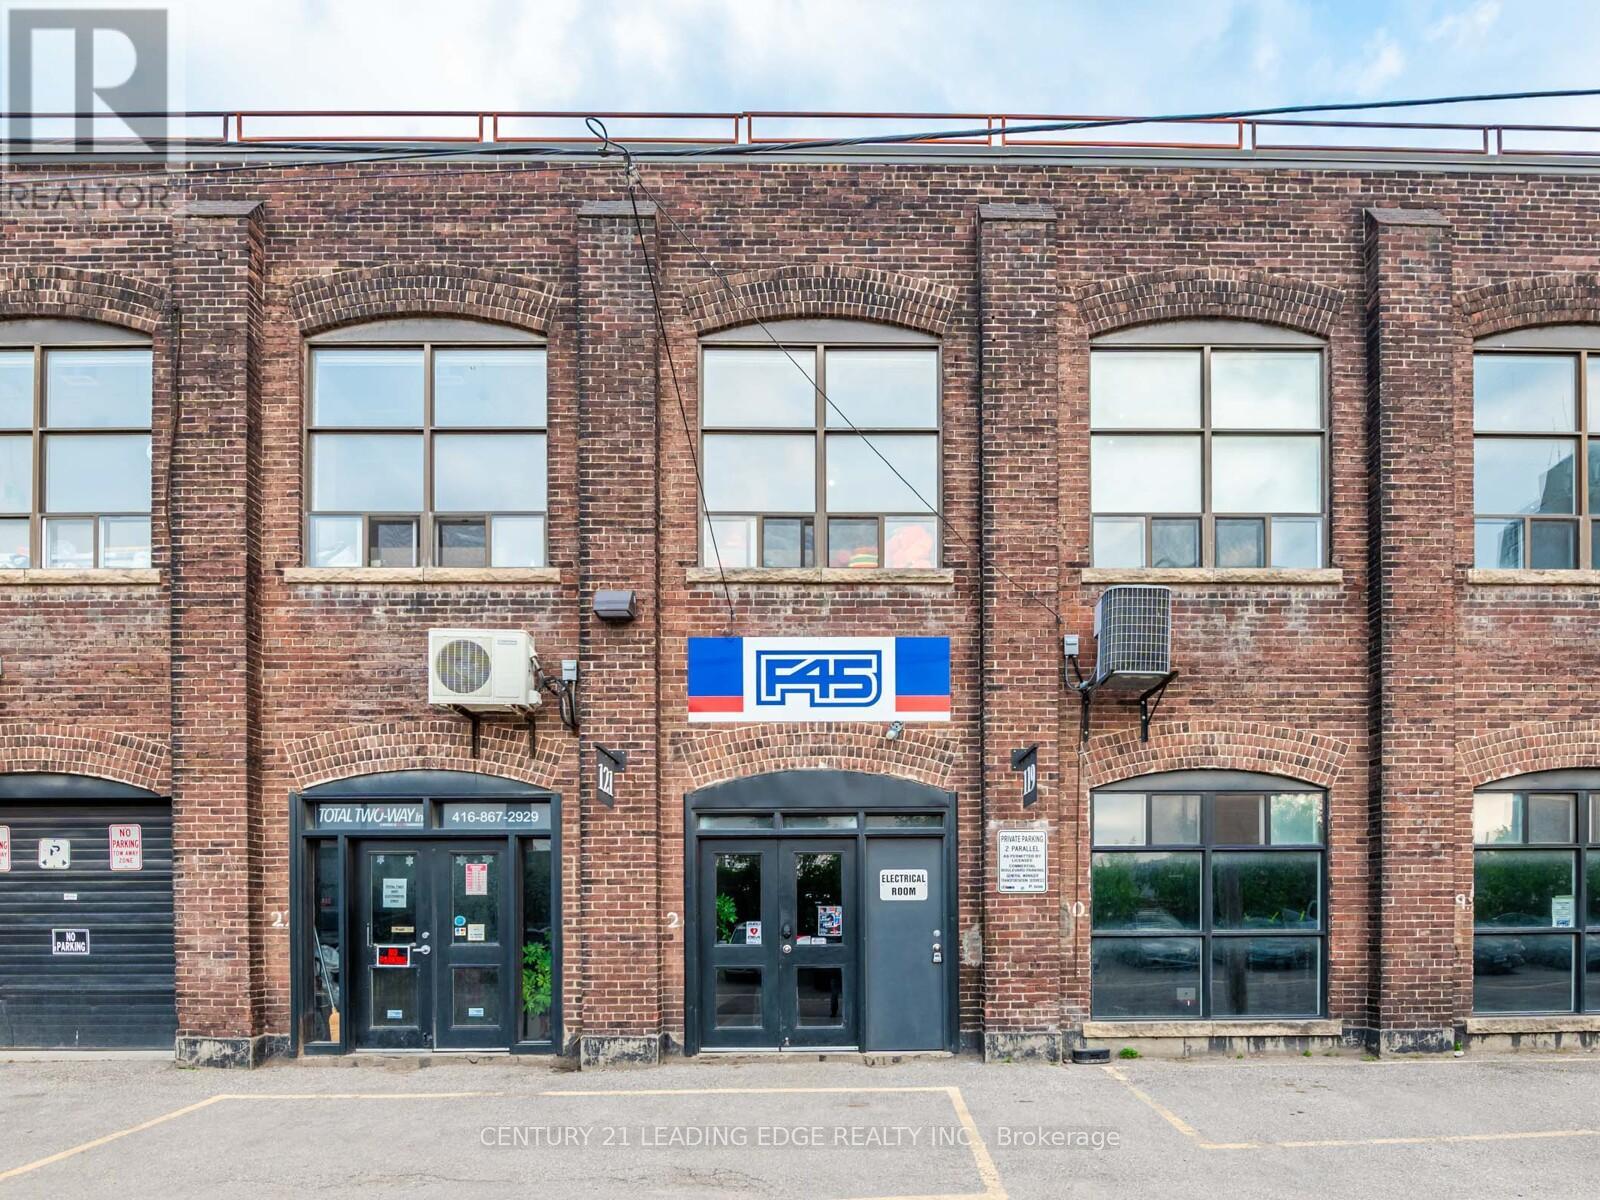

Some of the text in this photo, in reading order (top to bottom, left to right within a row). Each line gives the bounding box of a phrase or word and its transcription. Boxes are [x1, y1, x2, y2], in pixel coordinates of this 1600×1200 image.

[757, 650, 881, 706] F45
[319, 808, 352, 823] TOTAL
[355, 807, 416, 823] TWO-WAY
[452, 811, 539, 823] 416-867-2929
[119, 829, 131, 838] NO
[112, 839, 139, 849] PARKING
[1001, 835, 1044, 843] PRIVATE PARKING
[881, 874, 926, 883] ELECTRICAL
[891, 887, 917, 896] ROOM
[65, 931, 76, 942] NO
[56, 941, 86, 952] PARKING
